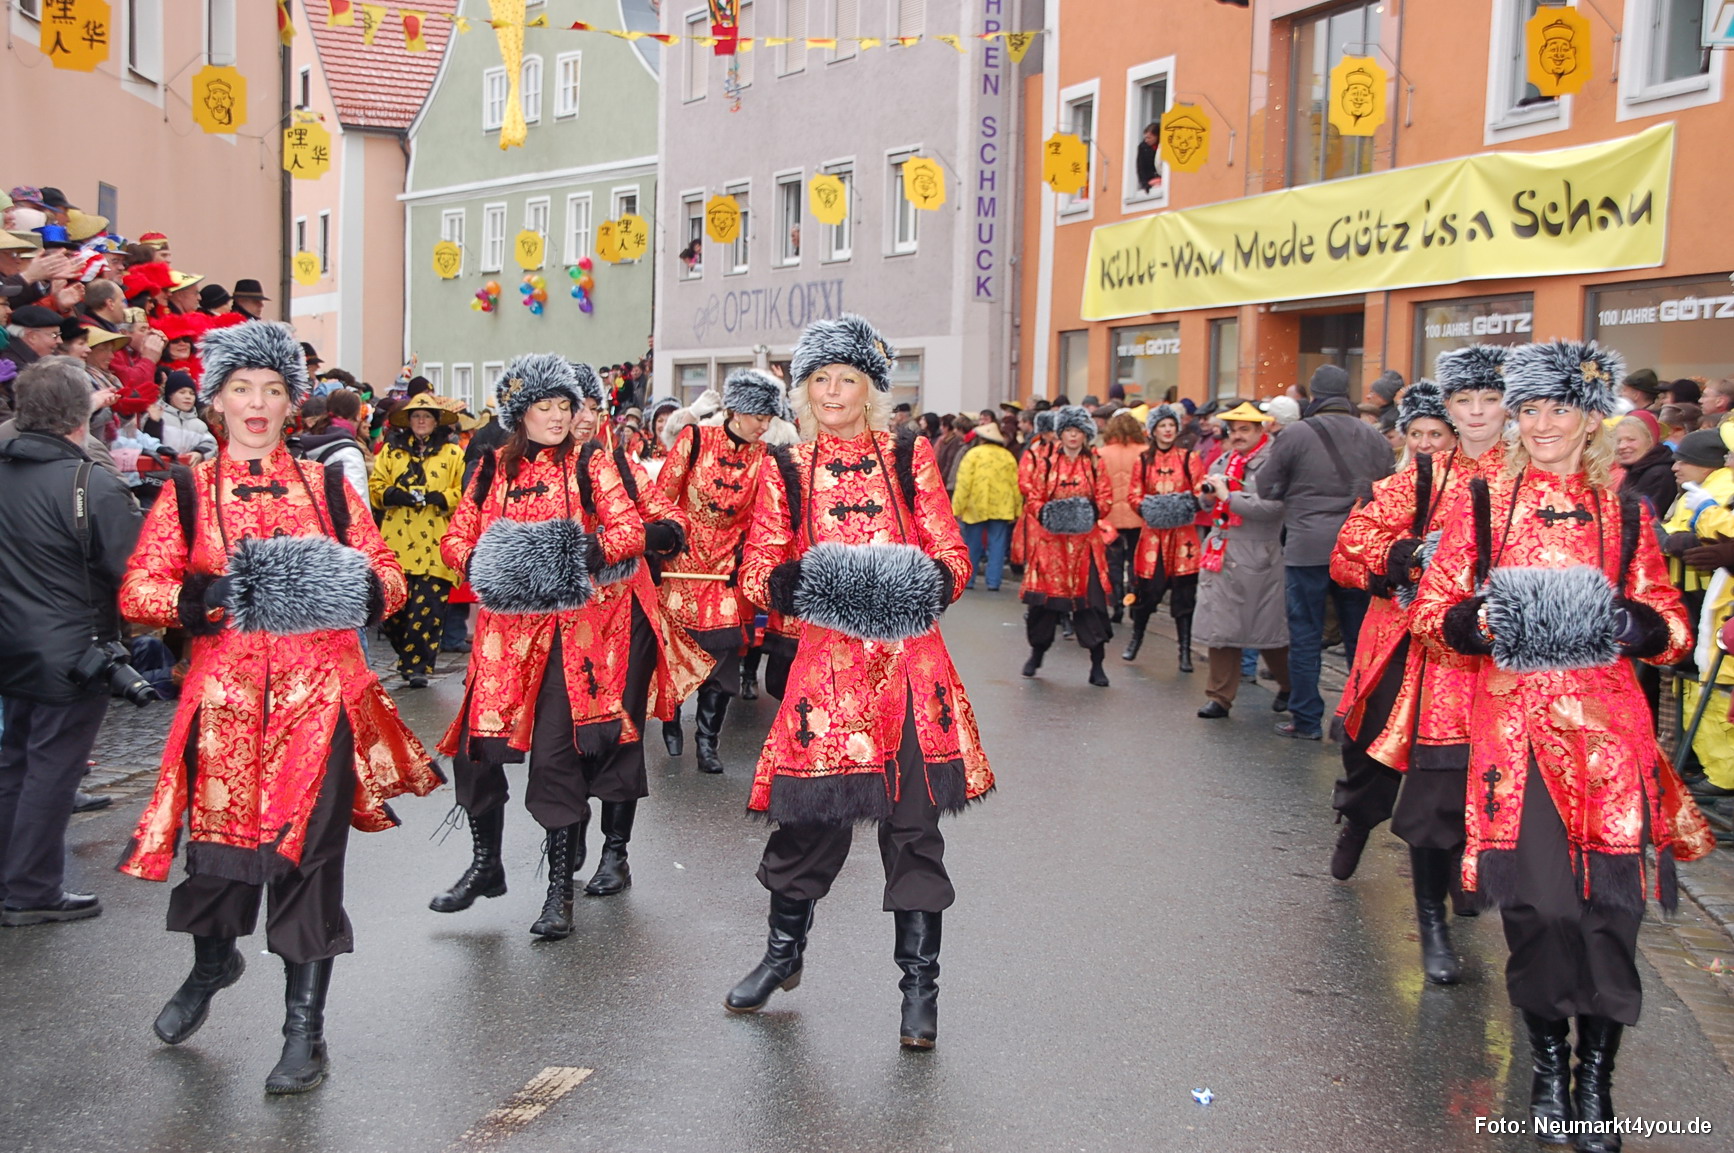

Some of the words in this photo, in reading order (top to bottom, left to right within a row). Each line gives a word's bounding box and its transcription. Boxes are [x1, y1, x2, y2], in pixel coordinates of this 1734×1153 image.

[976, 115, 998, 298] SCHMUCK
[1233, 220, 1315, 272] Mode
[1327, 208, 1410, 261] Götz
[1511, 178, 1653, 240] Schau
[723, 287, 783, 334] OPTIK
[1424, 324, 1441, 338] 100
[1441, 320, 1470, 338] JAHRE
[1472, 312, 1532, 336] GÖTZ
[1597, 310, 1618, 326] 100
[1619, 306, 1657, 325] JAHRE
[1659, 295, 1734, 322] GÖTZ
[1145, 338, 1181, 355] GÖTZ
[76, 487, 85, 517] Canon
